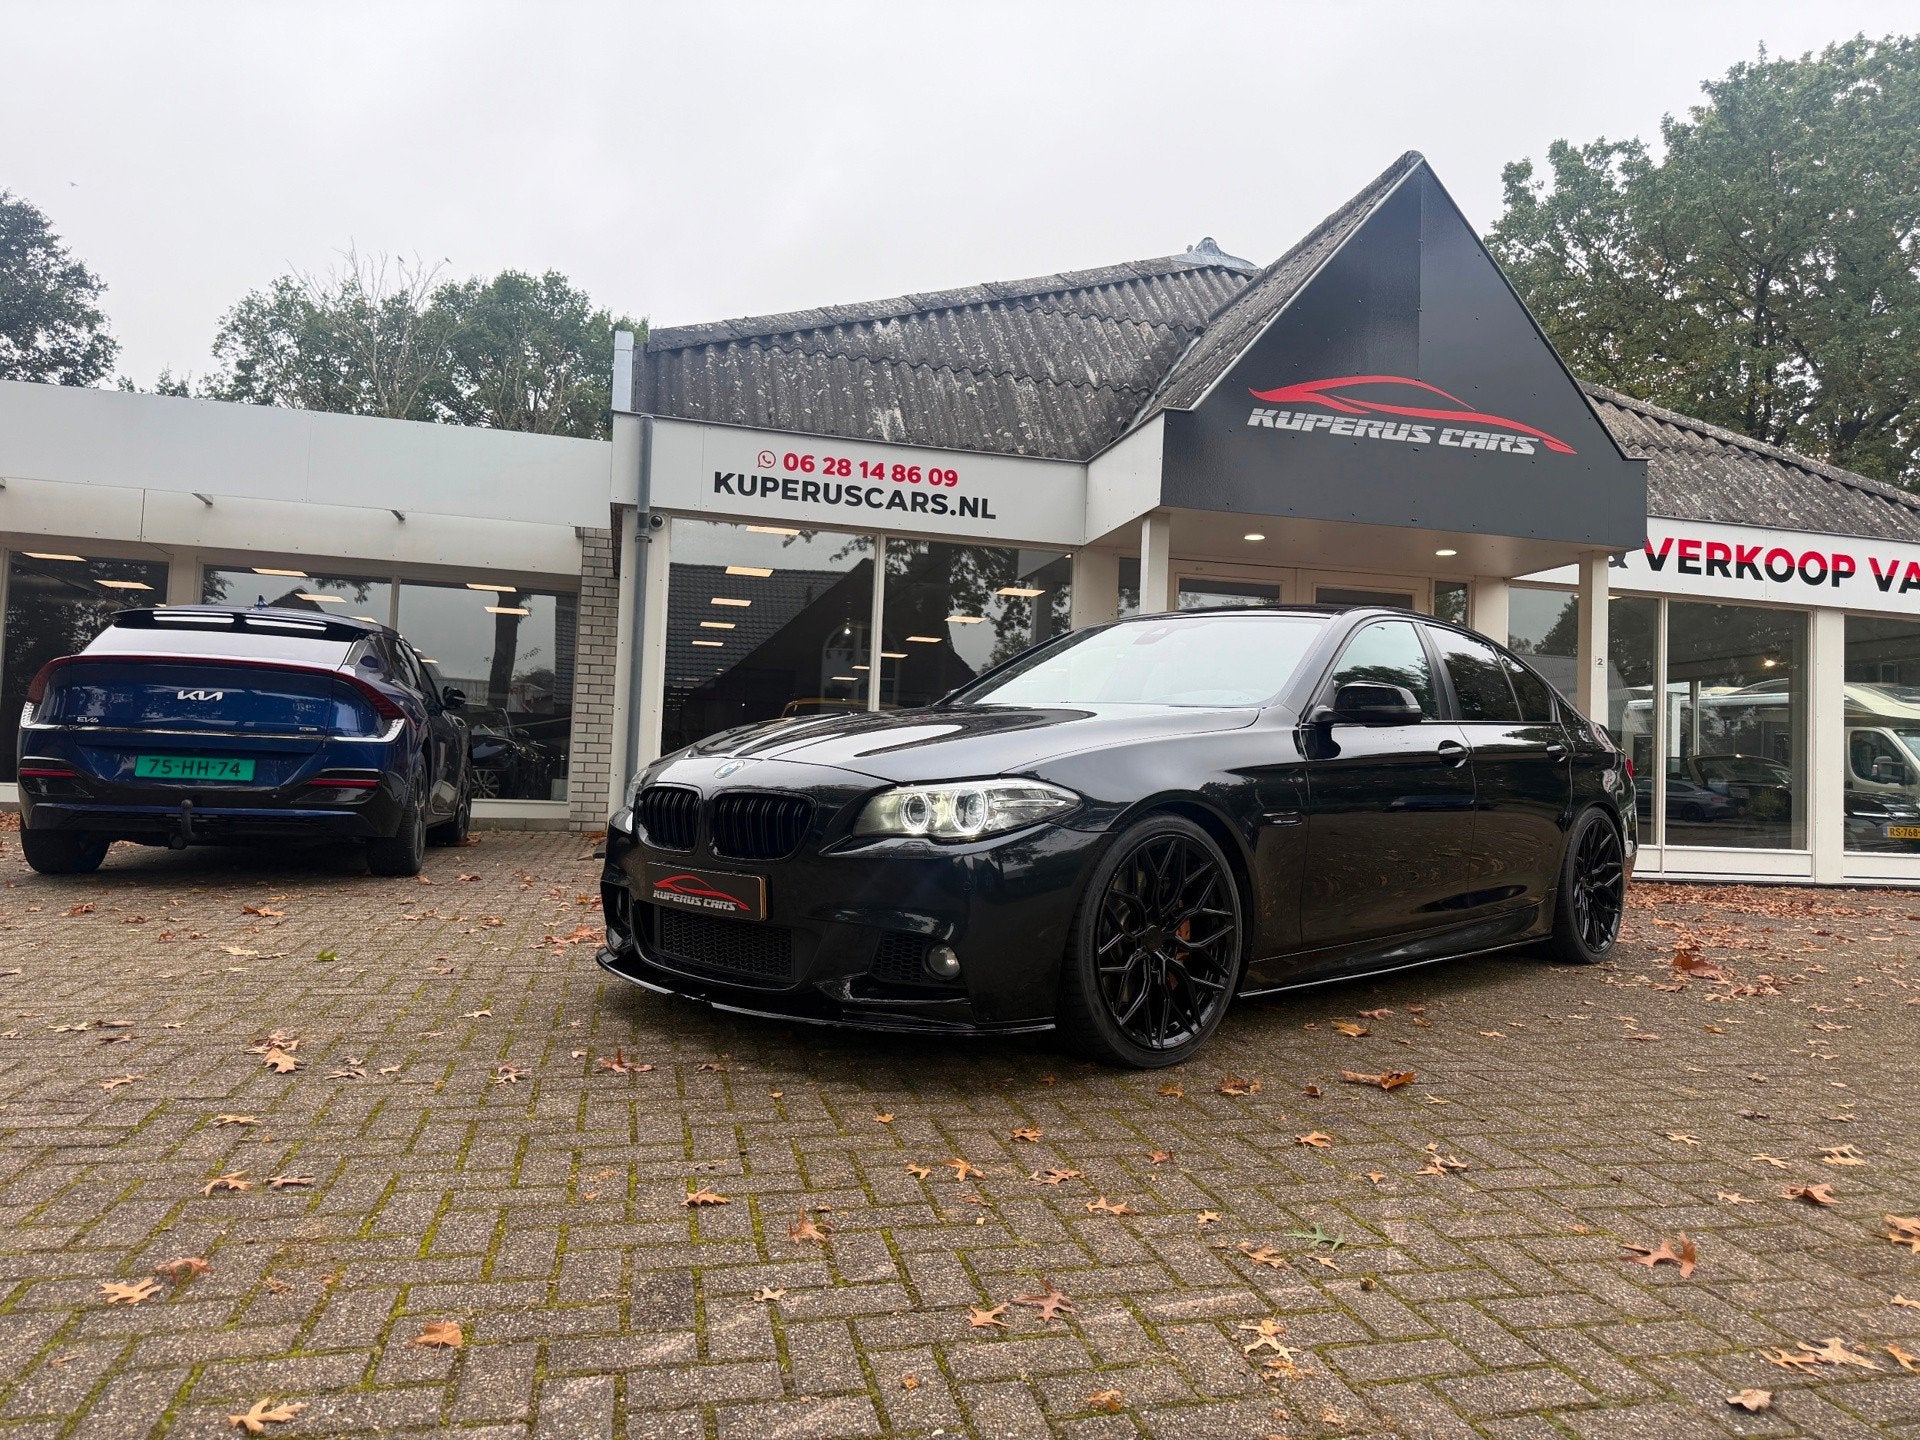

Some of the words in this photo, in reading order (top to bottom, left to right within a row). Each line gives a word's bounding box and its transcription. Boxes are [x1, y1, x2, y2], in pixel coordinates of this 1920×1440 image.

[1247, 408, 1435, 443] KUPERUS
[1438, 427, 1539, 455] CARS
[783, 453, 815, 473] 06
[823, 457, 852, 477] 28
[859, 461, 885, 481] 14
[891, 464, 922, 484] 86
[928, 467, 958, 487] 09
[713, 471, 997, 520] KUPERUSCARS.NL
[1645, 537, 1856, 588] VERKOOP
[1597, 657, 1604, 666] 2
[148, 758, 241, 777] 75-HH-74
[653, 889, 702, 906] KUPERUS
[703, 898, 737, 911] CARS
